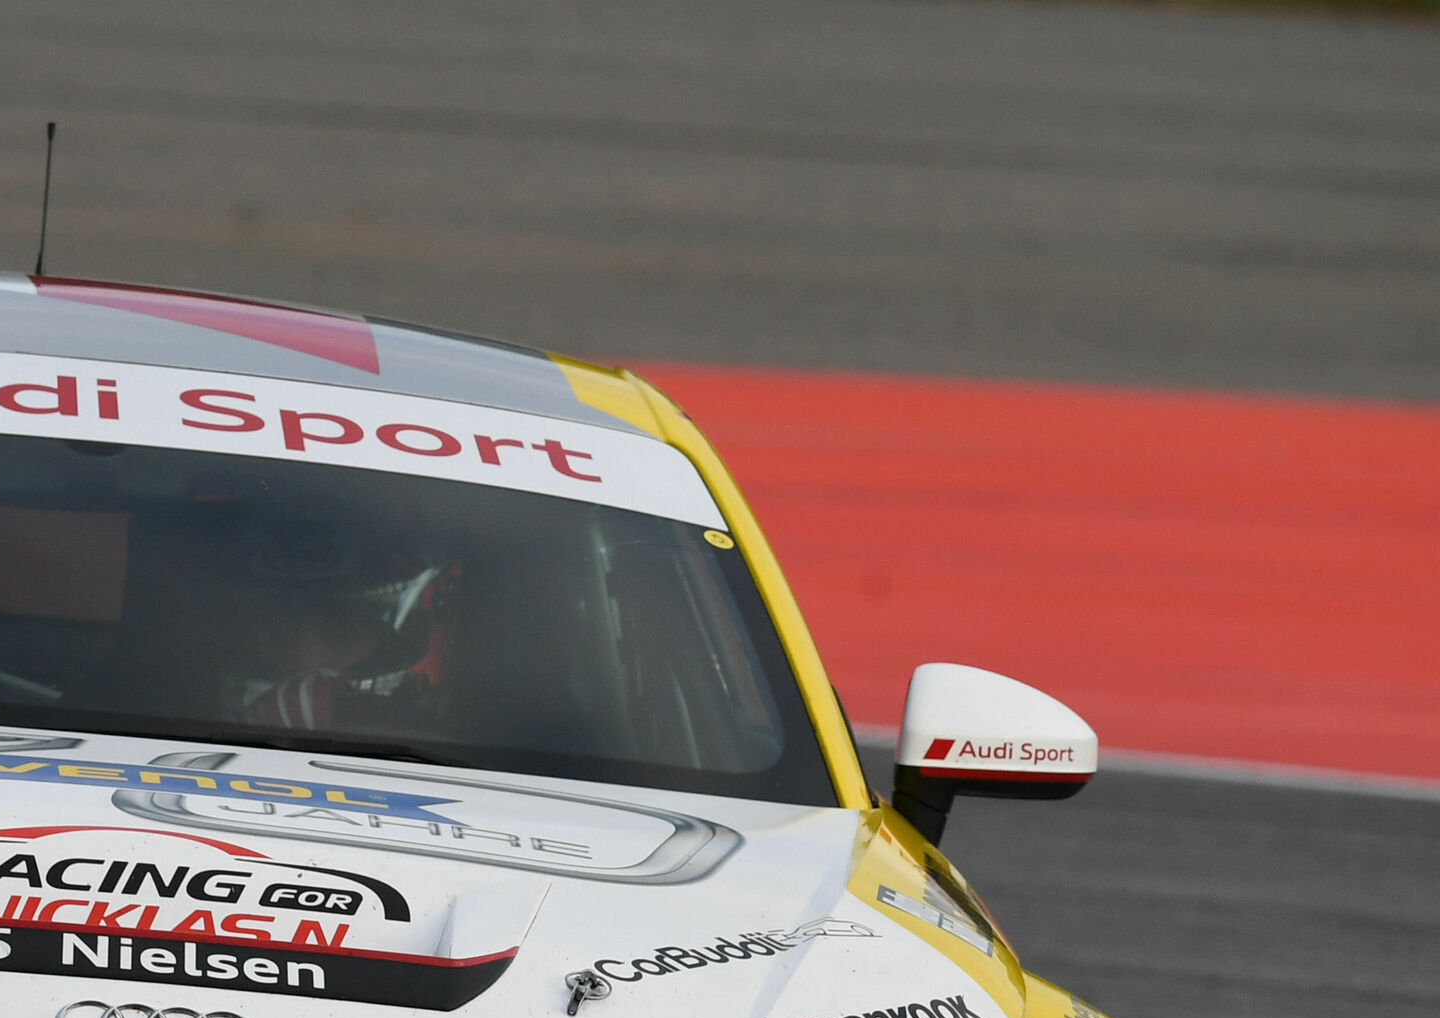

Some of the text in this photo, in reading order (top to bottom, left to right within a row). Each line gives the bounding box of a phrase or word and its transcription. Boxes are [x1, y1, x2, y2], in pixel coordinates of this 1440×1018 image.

[179, 389, 602, 482] Sport
[959, 741, 1074, 765] Audi Sport
[218, 802, 593, 859] JAHRE
[269, 889, 353, 910] FOR
[62, 932, 326, 989] Nielsen
